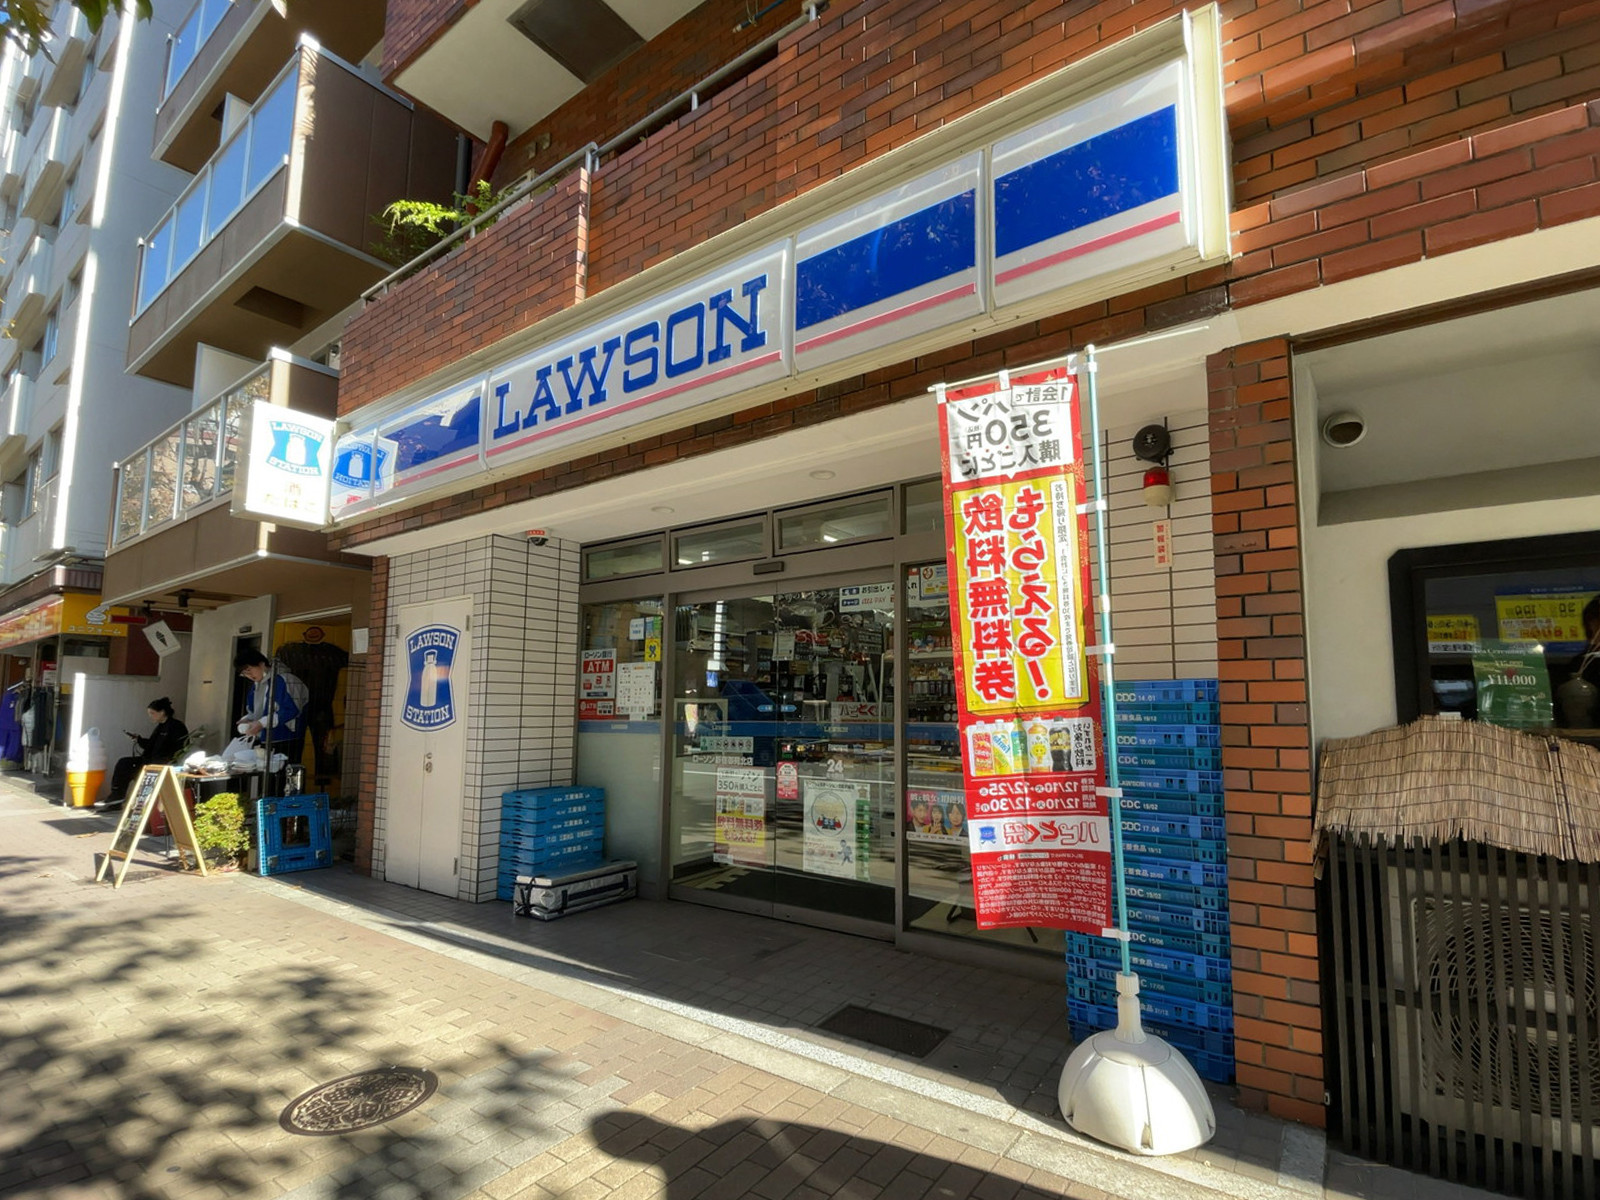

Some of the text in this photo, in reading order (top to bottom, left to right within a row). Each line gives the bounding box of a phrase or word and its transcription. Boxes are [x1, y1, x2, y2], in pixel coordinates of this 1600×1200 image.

[493, 273, 769, 440] LAWSON
[270, 421, 324, 444] LAWSON
[266, 456, 322, 476] STATION
[67, 624, 122, 637] ユニフォーム
[409, 632, 455, 654] LAWSON
[586, 660, 610, 673] ATM
[1487, 674, 1536, 686] ¥11,000
[1115, 693, 1136, 702] CDC
[405, 704, 450, 725] STATION
[1117, 735, 1138, 745] CDC
[827, 759, 844, 773] 24
[1118, 756, 1138, 765] CDC
[1120, 800, 1141, 809] CDC
[1121, 821, 1142, 832] CDC
[1125, 887, 1144, 897] CDC
